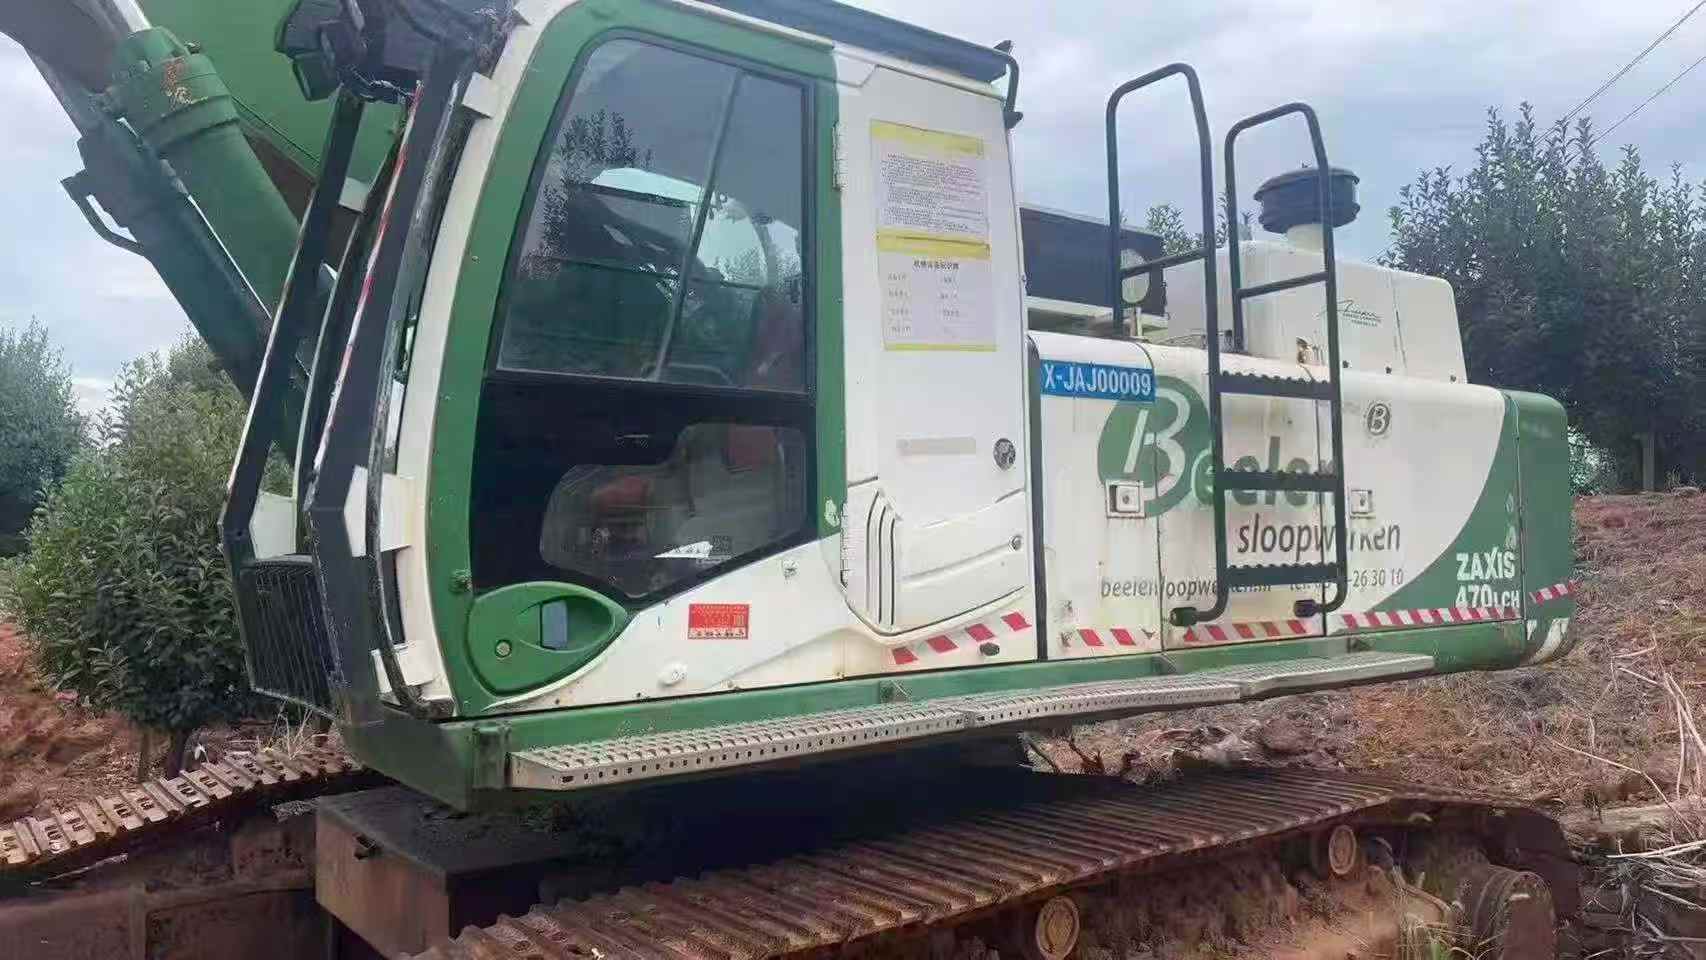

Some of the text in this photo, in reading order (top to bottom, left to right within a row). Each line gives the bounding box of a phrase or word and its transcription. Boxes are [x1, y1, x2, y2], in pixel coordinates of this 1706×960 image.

[1043, 363, 1152, 396] X-JAJ00009
[1237, 512, 1401, 562] sloopwrken
[1456, 546, 1516, 581] ZAXIS
